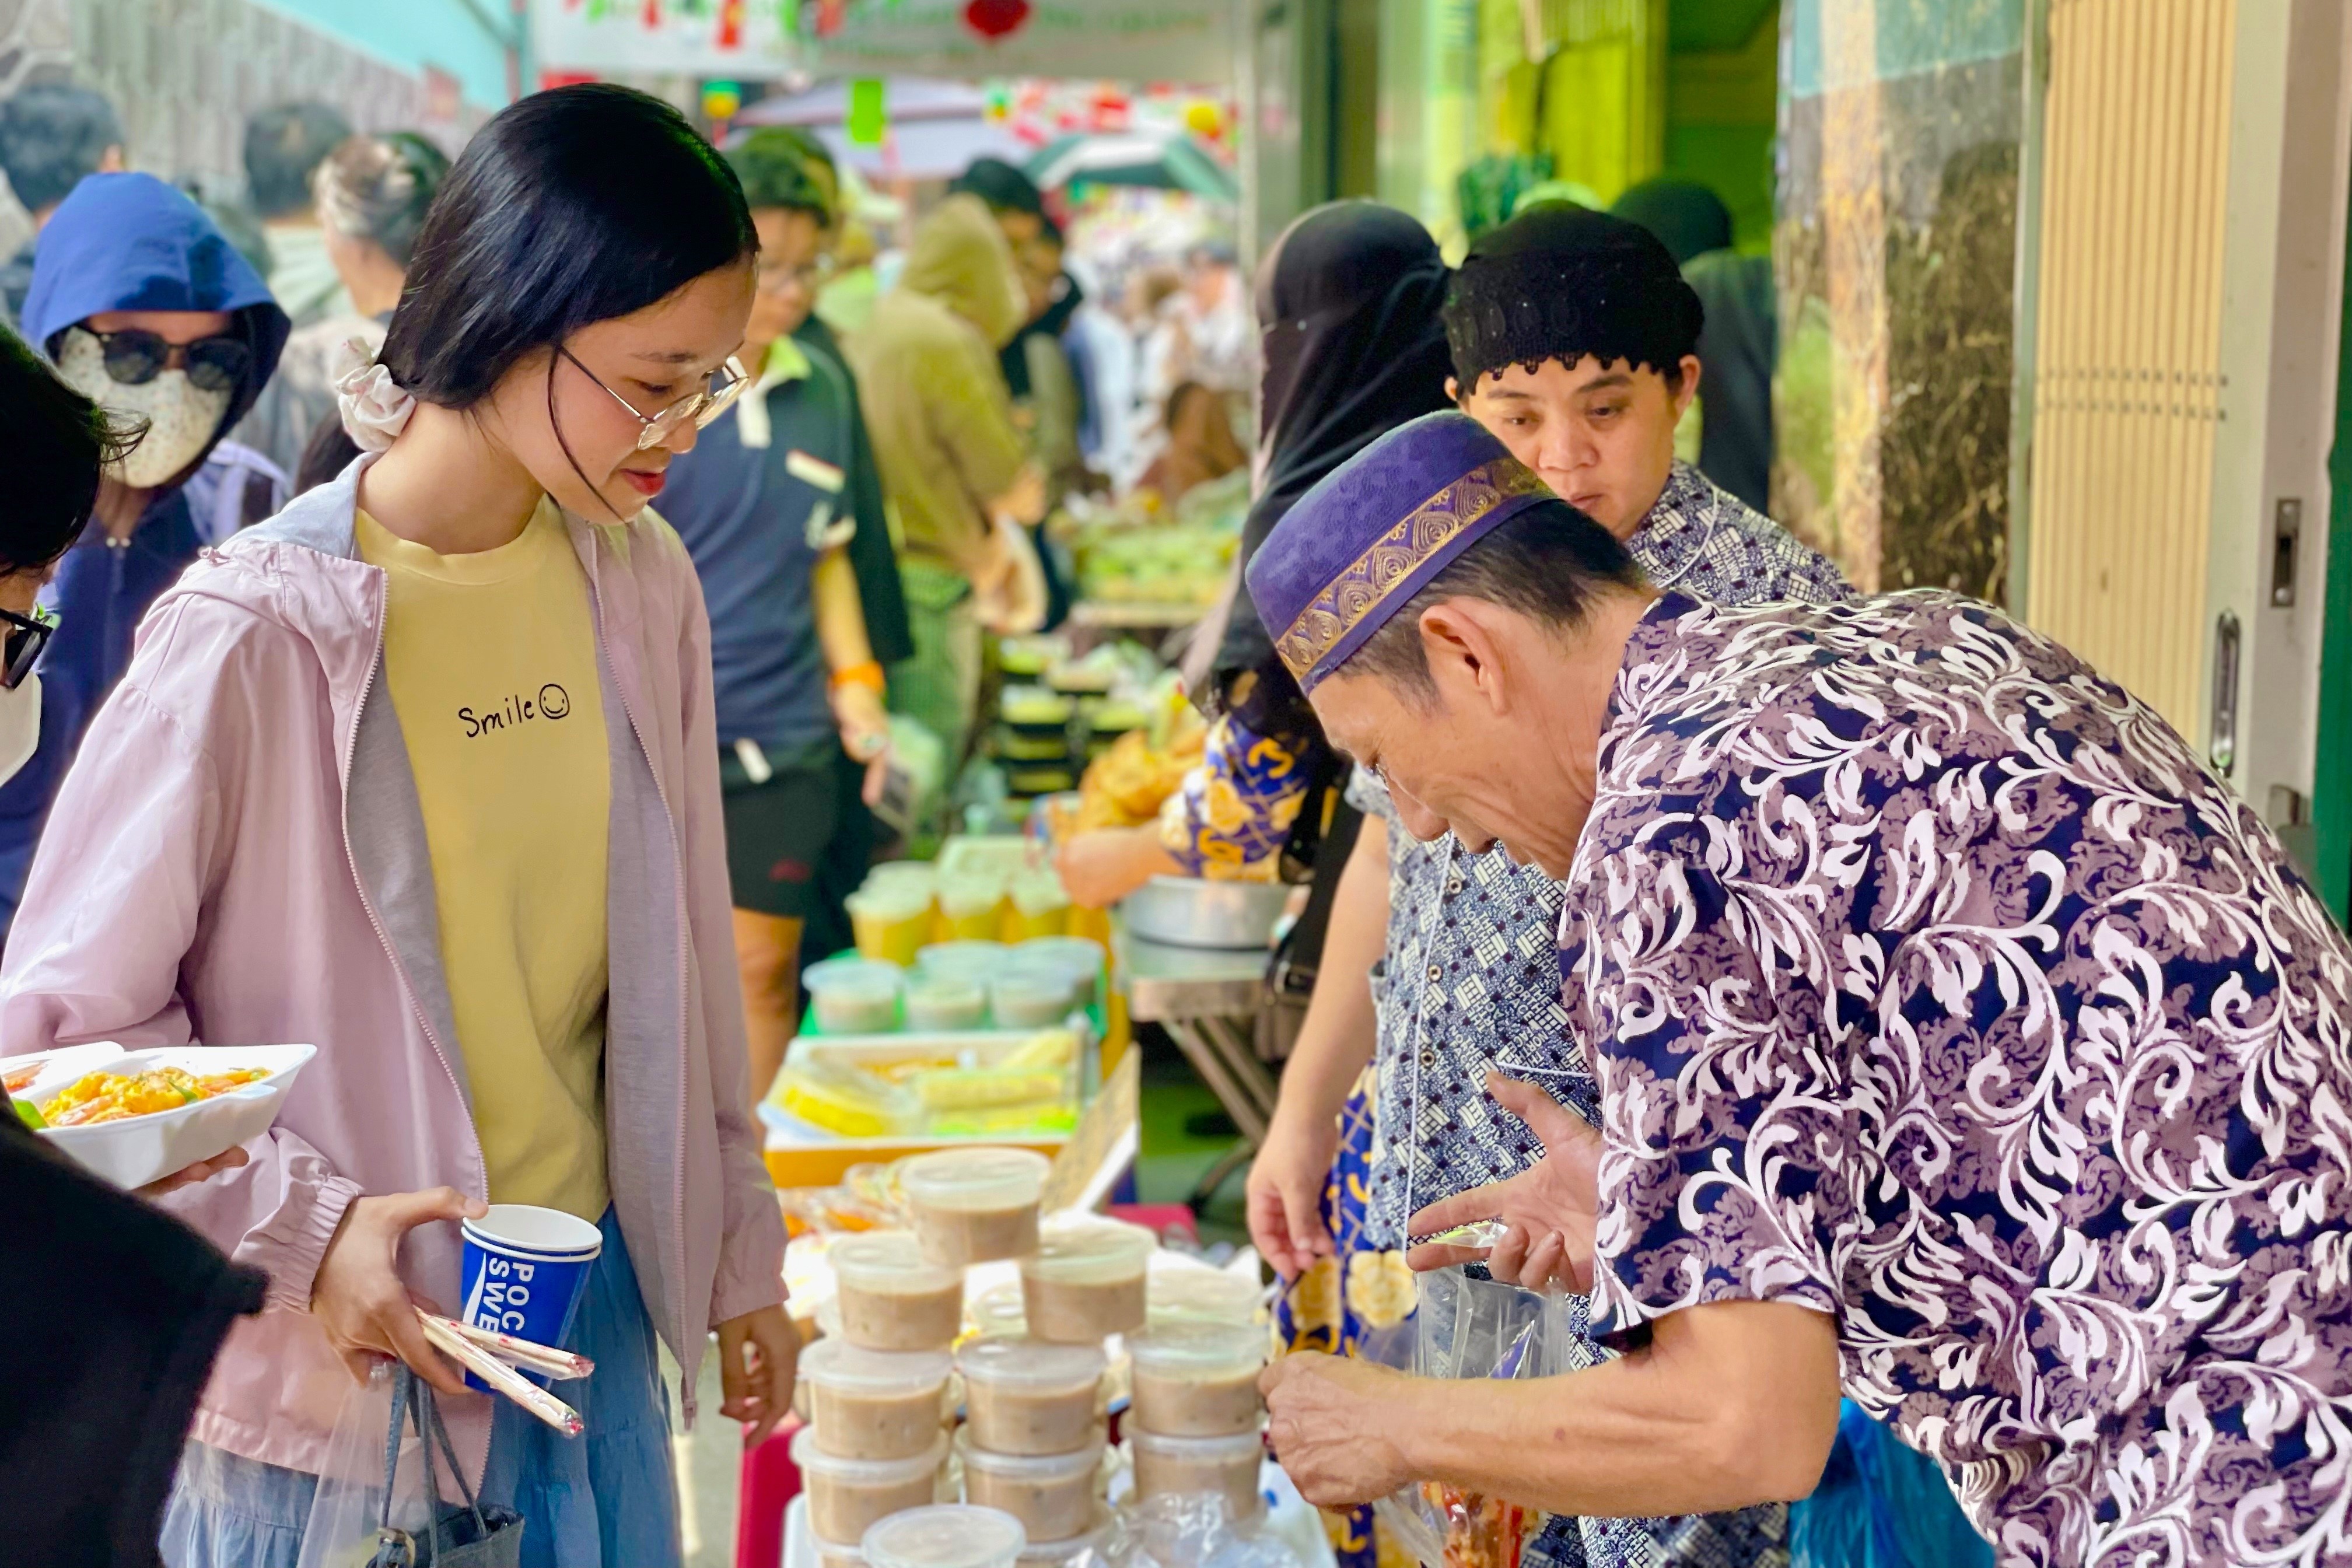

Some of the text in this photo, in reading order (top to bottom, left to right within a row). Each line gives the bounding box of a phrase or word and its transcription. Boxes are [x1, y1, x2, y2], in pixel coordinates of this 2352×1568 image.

[1709, 555, 1727, 578] THE
[1720, 549, 1742, 582] NORTH
[1732, 542, 1751, 568] FACE
[458, 694, 534, 738] Smile
[1485, 883, 1502, 907] THE
[1500, 869, 1521, 899] FACE
[1520, 864, 1542, 896] FACE
[1493, 876, 1519, 915] NORTH
[1437, 920, 1457, 950] FACE
[1460, 918, 1480, 949] FACE
[1462, 902, 1489, 942] NORTH
[1479, 911, 1497, 935] THE
[1433, 935, 1455, 965] NORT
[1531, 954, 1553, 978] THE
[1479, 994, 1504, 1020] ACE
[1504, 991, 1535, 1021] FACE
[1506, 975, 1544, 1014] NORTH
[1530, 982, 1553, 1007] THE
[1466, 1009, 1487, 1034] THE
[1449, 1025, 1479, 1066] NORTH
[1466, 1036, 1485, 1060] THE
[1507, 1027, 1534, 1052] FACE
[1514, 1031, 1548, 1062] NORTH
[1450, 1041, 1471, 1070] FACE
[1430, 1062, 1454, 1088] NOR
[1545, 1080, 1568, 1103] THE
[1500, 1108, 1524, 1132] NOR
[1427, 1163, 1456, 1190] FACE
[1451, 1157, 1480, 1188] FACE
[478, 1257, 510, 1334] SWE
[502, 1262, 535, 1331] POC
[1609, 1527, 1633, 1559] FACE
[1614, 1518, 1641, 1550] ORTH
[1625, 1518, 1649, 1543] THE
